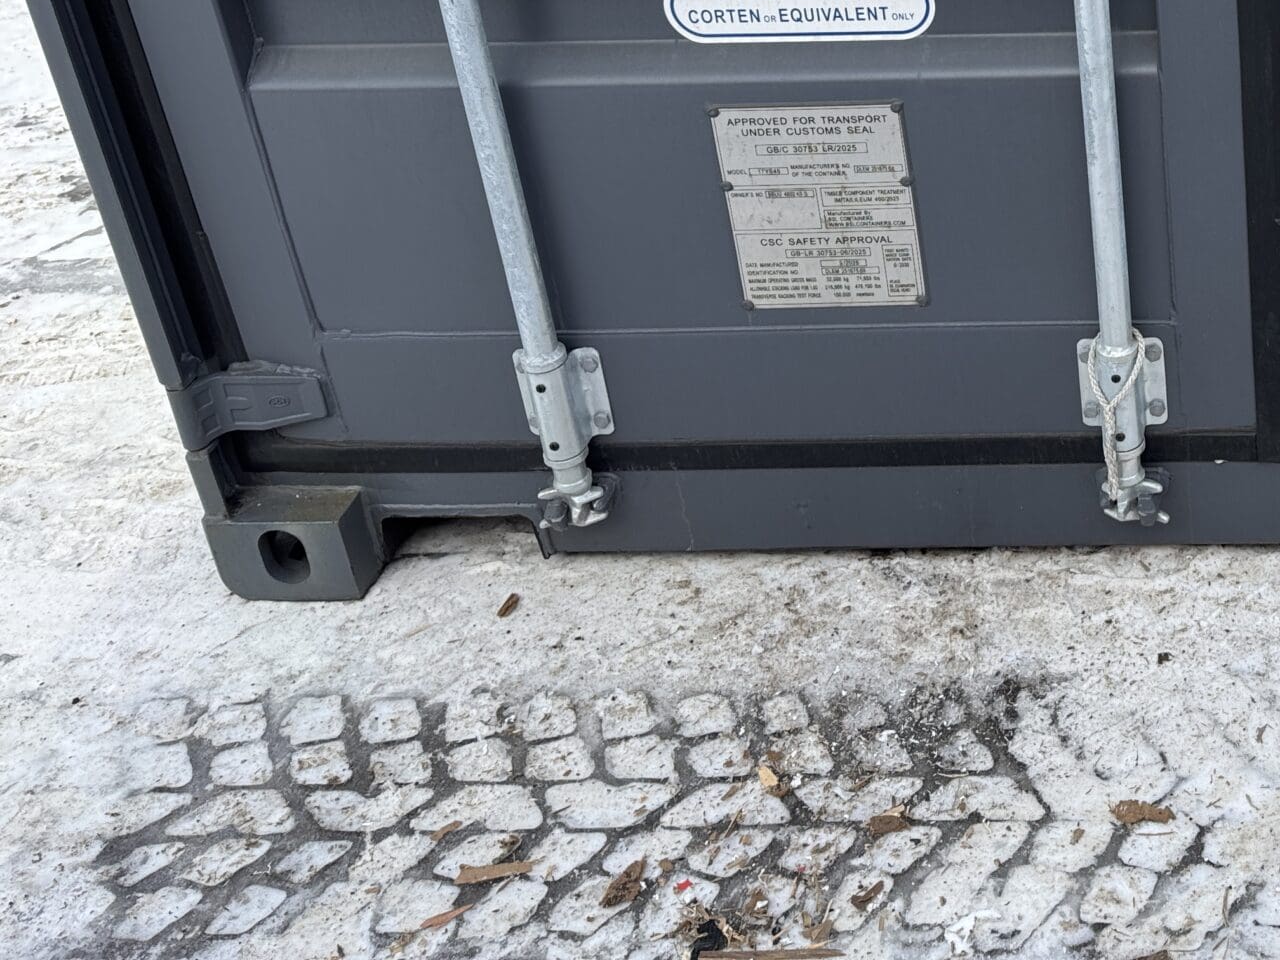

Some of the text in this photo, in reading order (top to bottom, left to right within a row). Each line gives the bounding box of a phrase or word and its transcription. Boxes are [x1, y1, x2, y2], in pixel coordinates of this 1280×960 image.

[688, 6, 915, 24] CORTEN OR EQUIVALENT ONLY
[727, 114, 888, 127] APPROVED FOR TRANSPORT
[741, 125, 876, 137] UNDER CUSTOMS SEAL
[766, 143, 857, 154] GB/C 30753 LR/2025
[760, 235, 893, 247] CSC SAFETY APPROVAL
